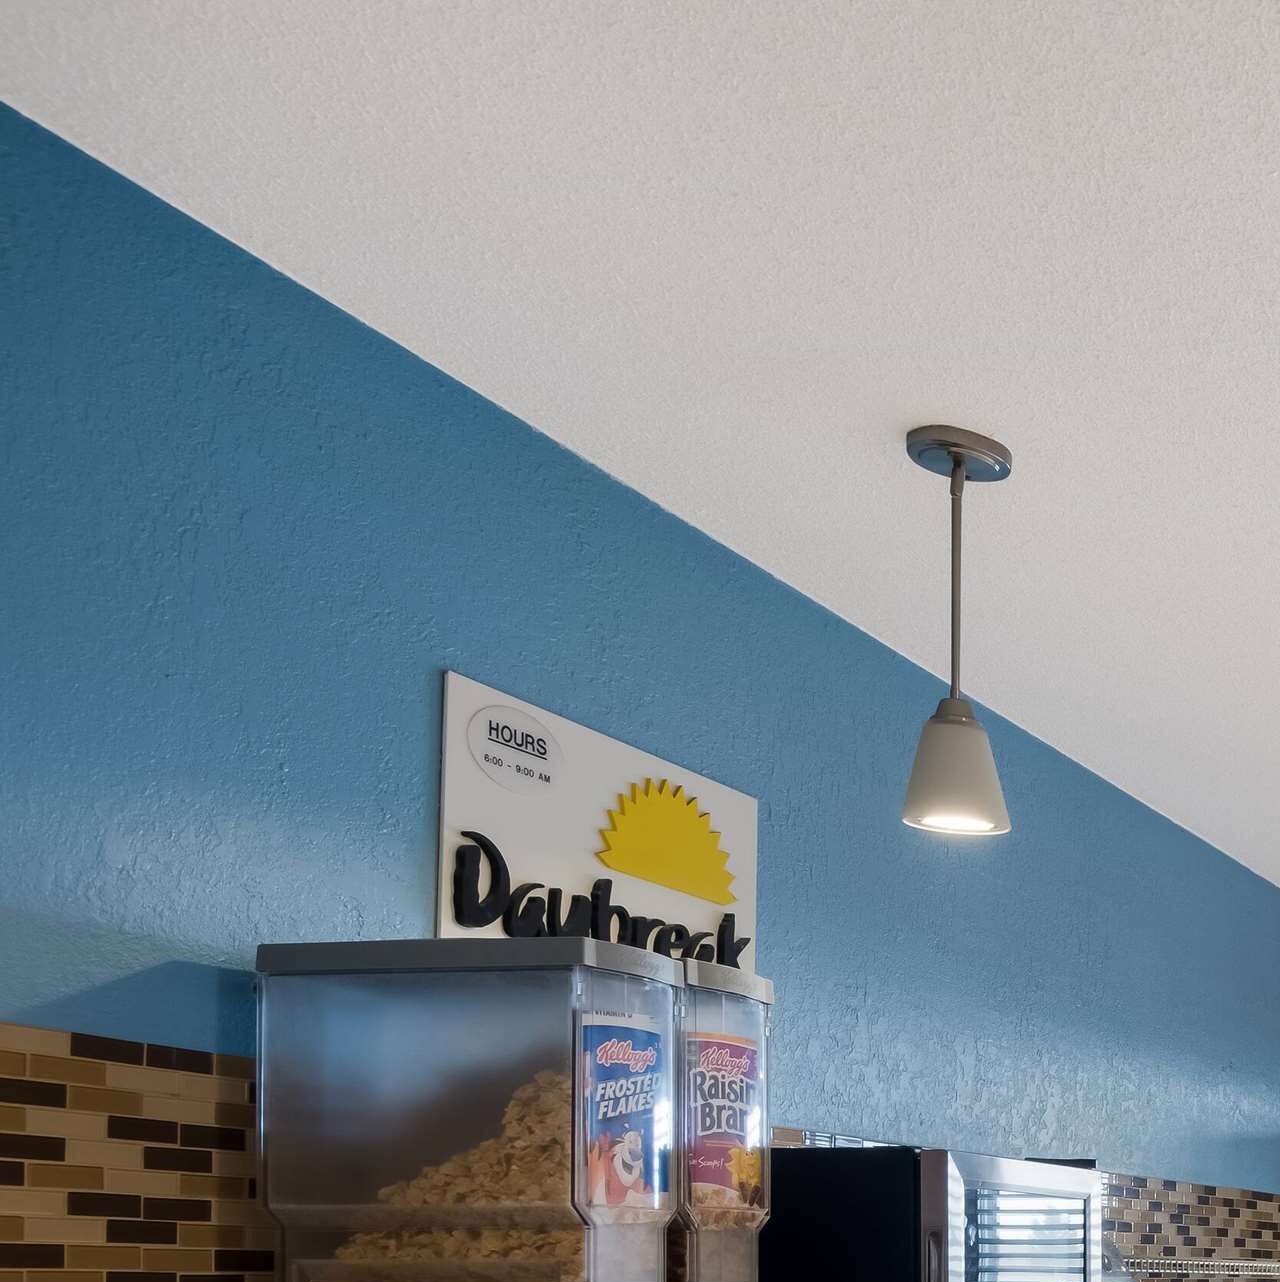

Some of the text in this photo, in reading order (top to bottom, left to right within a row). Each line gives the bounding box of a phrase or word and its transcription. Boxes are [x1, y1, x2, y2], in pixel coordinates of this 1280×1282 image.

[488, 720, 547, 756] HOURS
[515, 765, 535, 778] 9:00
[538, 773, 551, 784] AM
[597, 1038, 657, 1072] Kellogg's
[700, 1046, 750, 1078] Kellogg's
[595, 1072, 661, 1102] FROSTED
[598, 1092, 655, 1120] FLAKES
